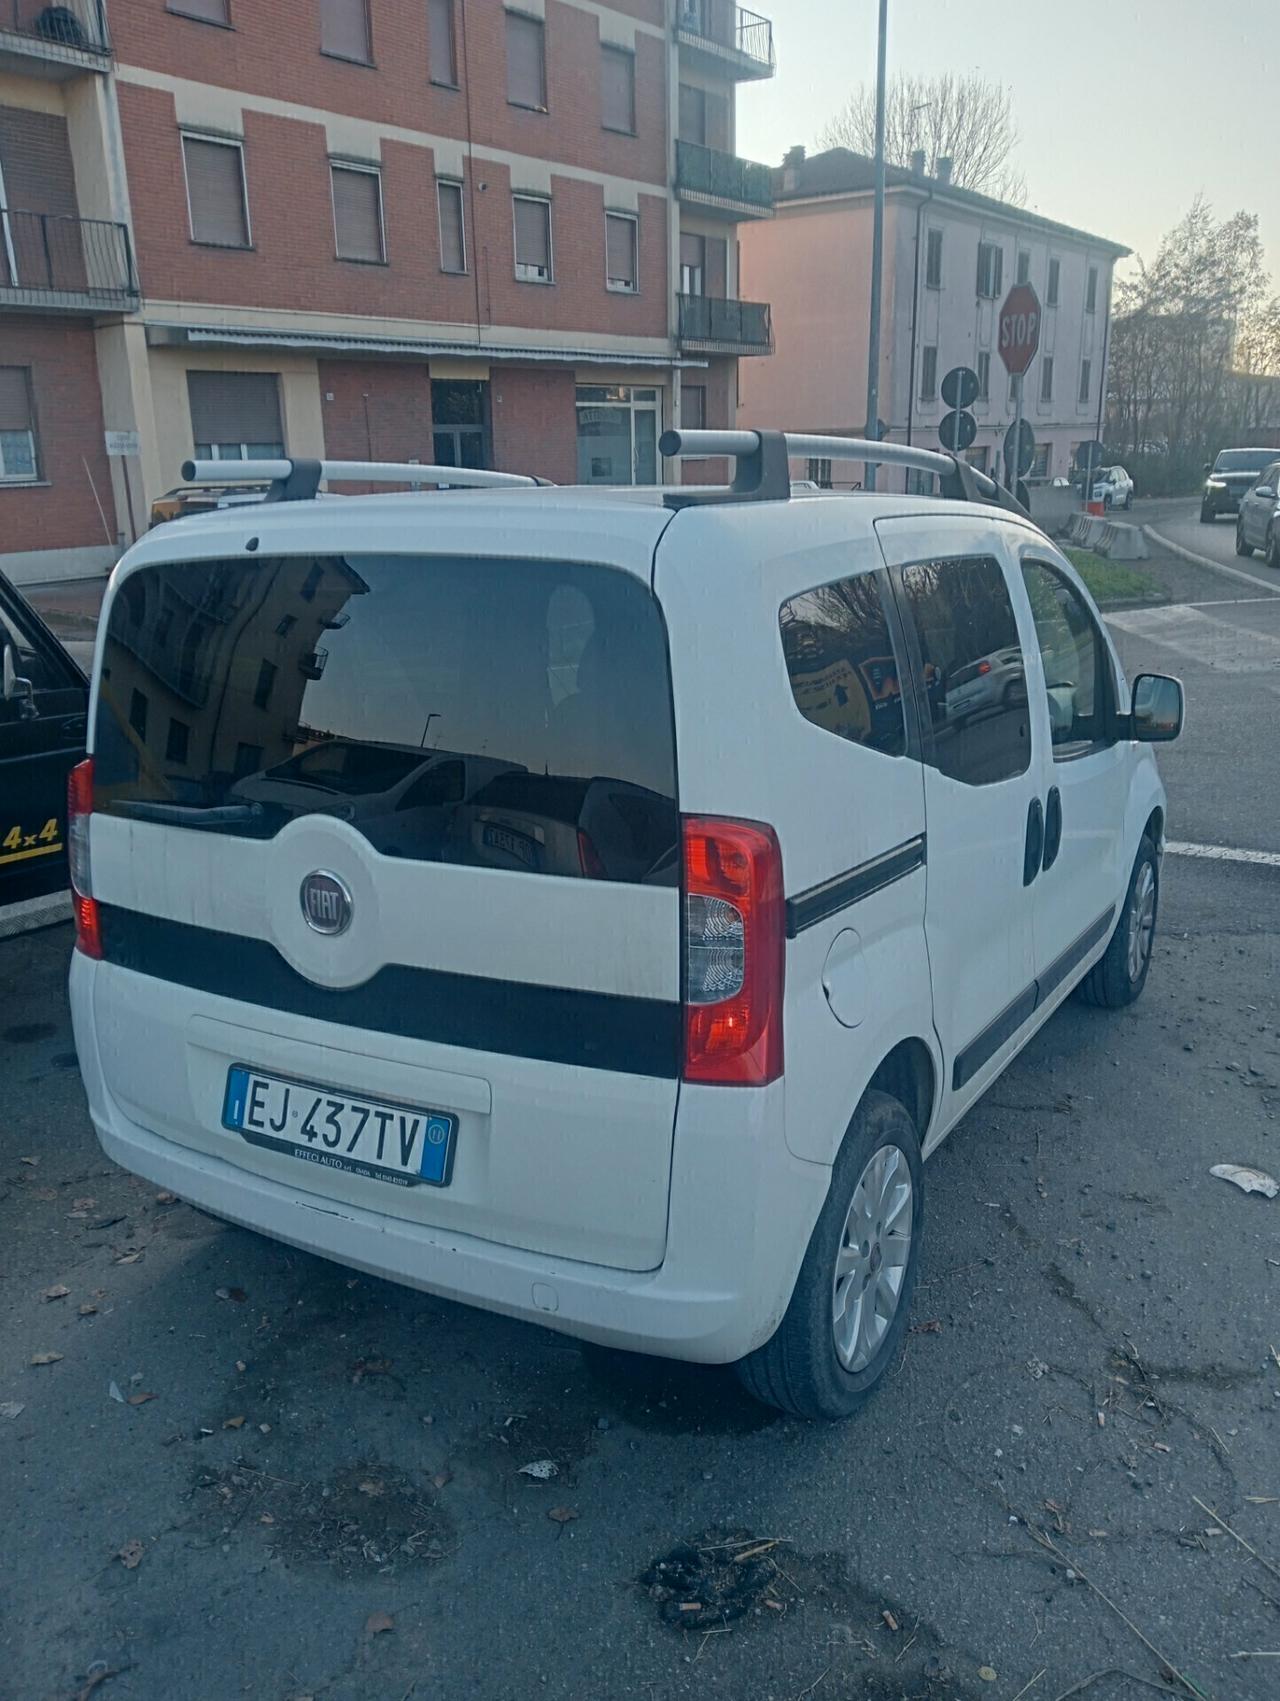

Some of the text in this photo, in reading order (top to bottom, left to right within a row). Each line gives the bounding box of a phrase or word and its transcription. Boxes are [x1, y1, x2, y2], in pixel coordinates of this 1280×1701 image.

[1002, 312, 1037, 348] STOP
[2, 818, 58, 849] 4x4
[309, 888, 339, 920] FIAT
[294, 1148, 319, 1163] EFFECI
[320, 1155, 343, 1170] AUTO
